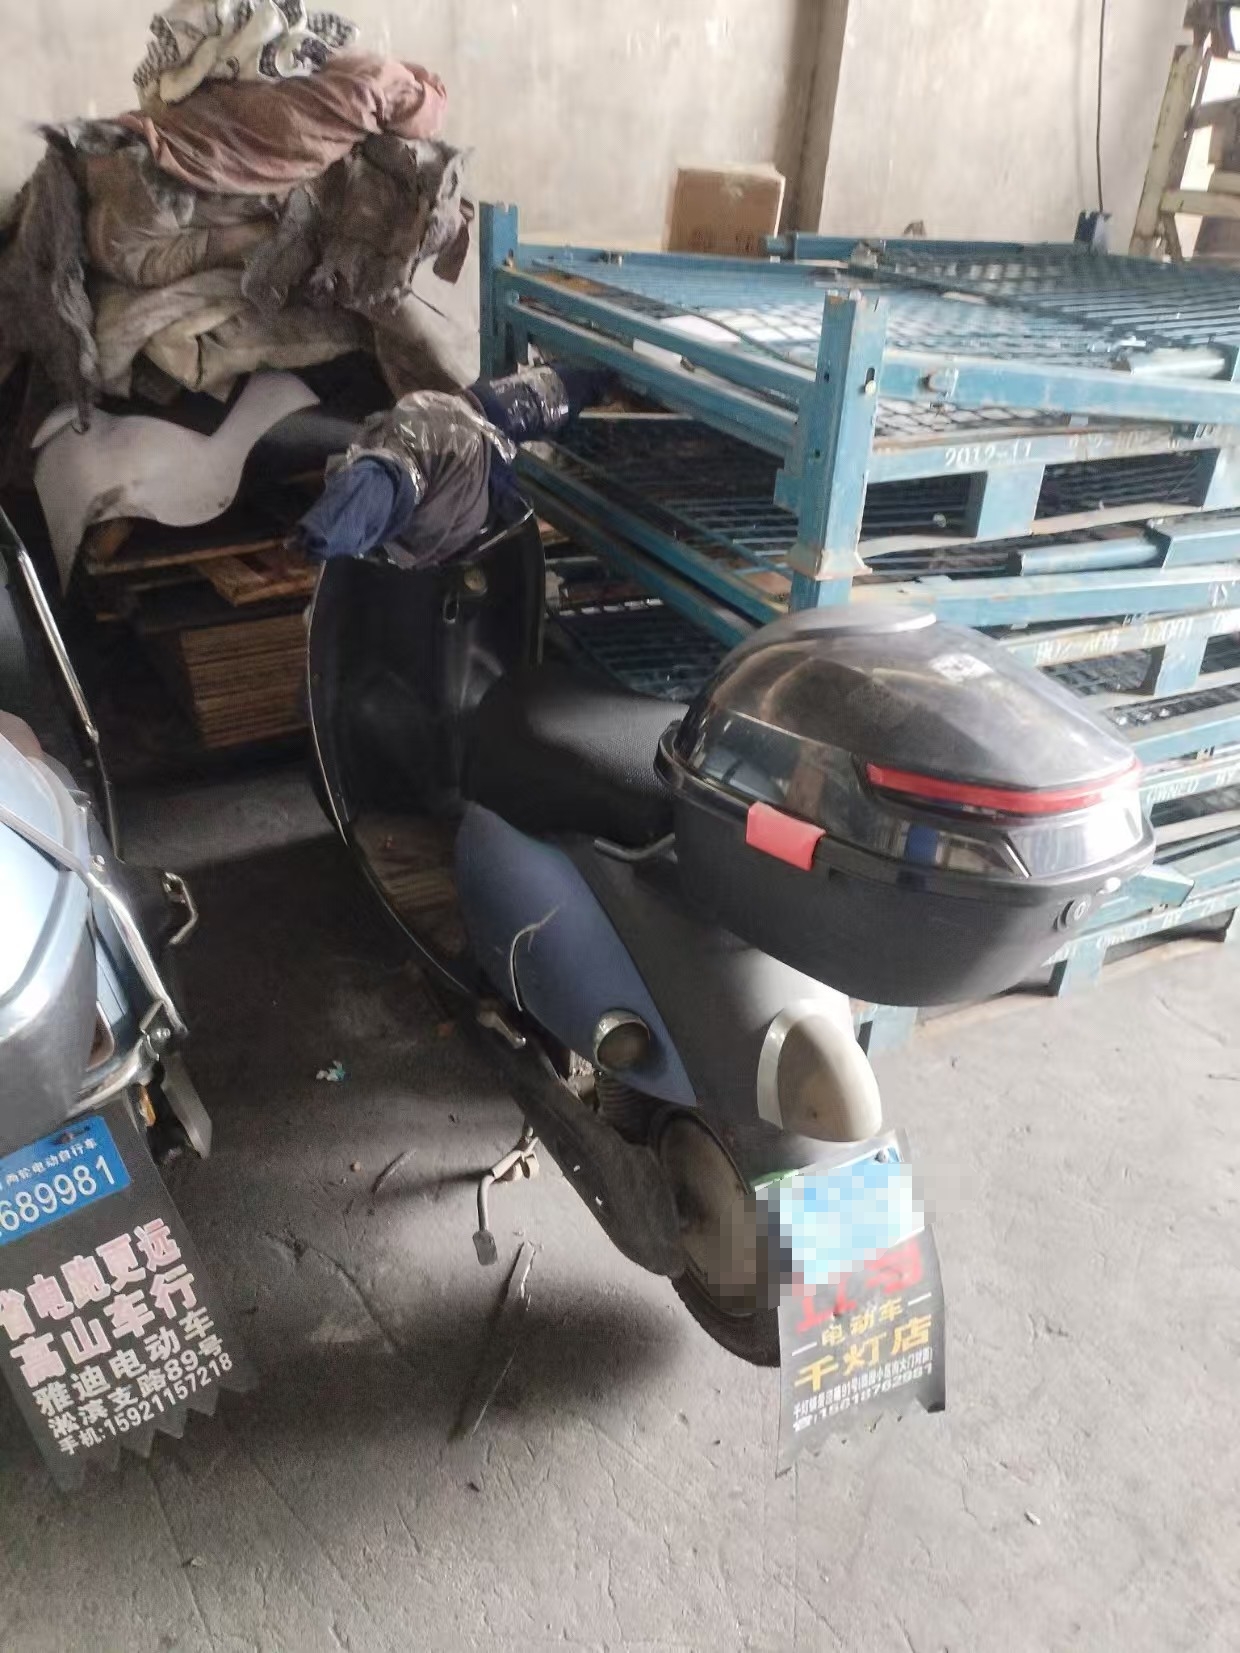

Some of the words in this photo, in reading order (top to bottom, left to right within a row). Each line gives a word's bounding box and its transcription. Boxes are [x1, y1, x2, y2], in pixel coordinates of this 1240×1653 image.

[0, 1155, 115, 1234] 689981
[10, 1264, 196, 1388] 高山车行
[32, 1307, 214, 1416] 雅迪电动车
[794, 1314, 932, 1392] 千灯店
[821, 1298, 904, 1347] 电动车
